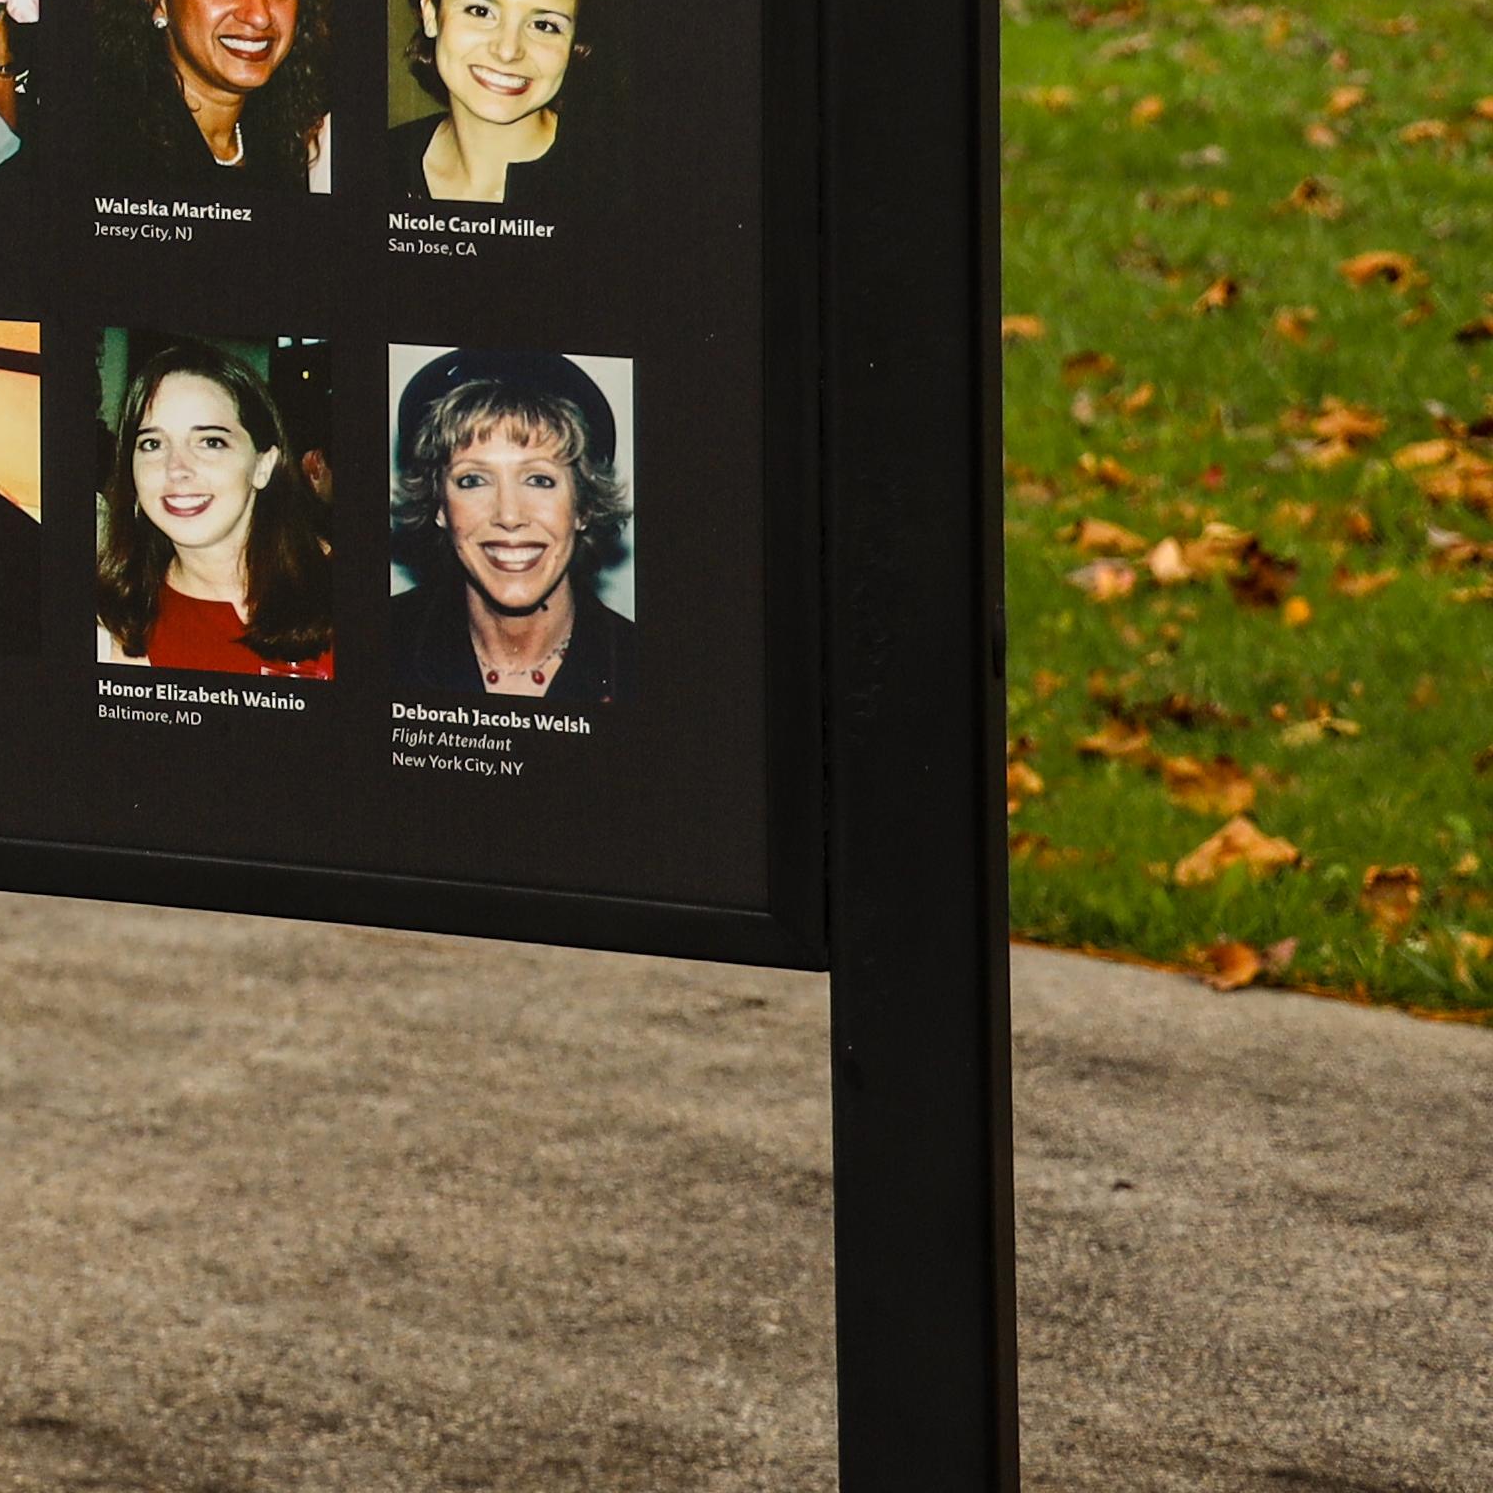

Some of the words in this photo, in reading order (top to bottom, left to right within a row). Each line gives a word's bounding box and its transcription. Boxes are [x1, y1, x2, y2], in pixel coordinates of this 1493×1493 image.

[389, 213, 445, 231] Nicole
[449, 217, 495, 234] Carol
[500, 219, 554, 237] Miller
[389, 238, 415, 252] San
[419, 240, 452, 256] Jose,
[456, 242, 477, 256] CA
[99, 680, 153, 698] Honor
[156, 684, 238, 705] Elizabeth
[242, 691, 305, 710] Wainio
[99, 704, 172, 724] Baltimore,
[176, 711, 201, 725] MD
